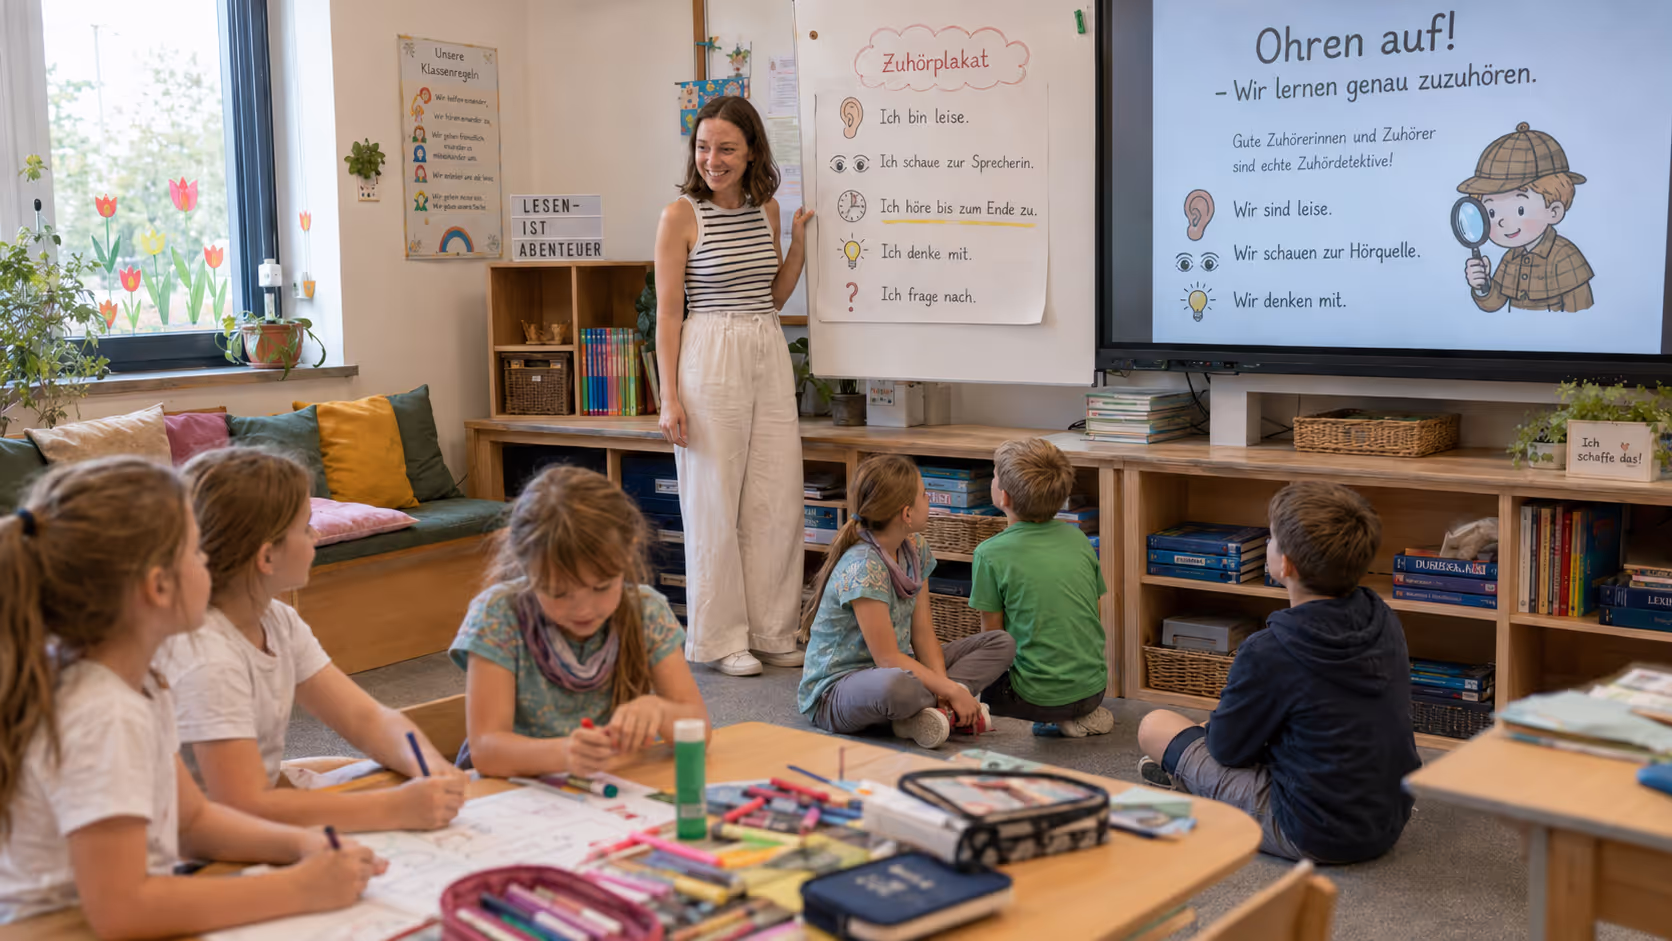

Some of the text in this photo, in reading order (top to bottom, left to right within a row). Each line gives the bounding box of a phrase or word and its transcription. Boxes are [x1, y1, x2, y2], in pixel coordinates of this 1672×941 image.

[1255, 10, 1456, 65] Ohren auf!
[435, 47, 465, 62] Unsere
[881, 48, 990, 78] Zuhörplakat
[421, 62, 480, 83] Klassenregeln
[1233, 78, 1269, 101] Wir
[1275, 74, 1338, 100] lernen
[1346, 74, 1409, 103] genau
[1418, 63, 1537, 90] zuzuhören.
[880, 107, 969, 124] Ich bin leise.
[1232, 125, 1437, 149] Gute Zuhörerinnen und Zuhörer
[880, 154, 1034, 176] Ich schaue zur Sprecherin.
[1232, 152, 1394, 173] sind echte Zuhördetektive!
[880, 198, 1038, 217] Ich höre bis zum Ende zu.
[1233, 199, 1332, 218] Wir sind leise.
[522, 221, 547, 235] IST
[519, 242, 601, 257] ABENTEUER
[881, 243, 972, 261] Ich denke mit.
[1233, 241, 1421, 264] Wir schauen zur Hörquelle.
[881, 286, 977, 307] Ich frage nach.
[1233, 291, 1347, 309] Wir denken mit.
[1581, 437, 1600, 448] Ich
[1577, 451, 1642, 465] schaffe das!
